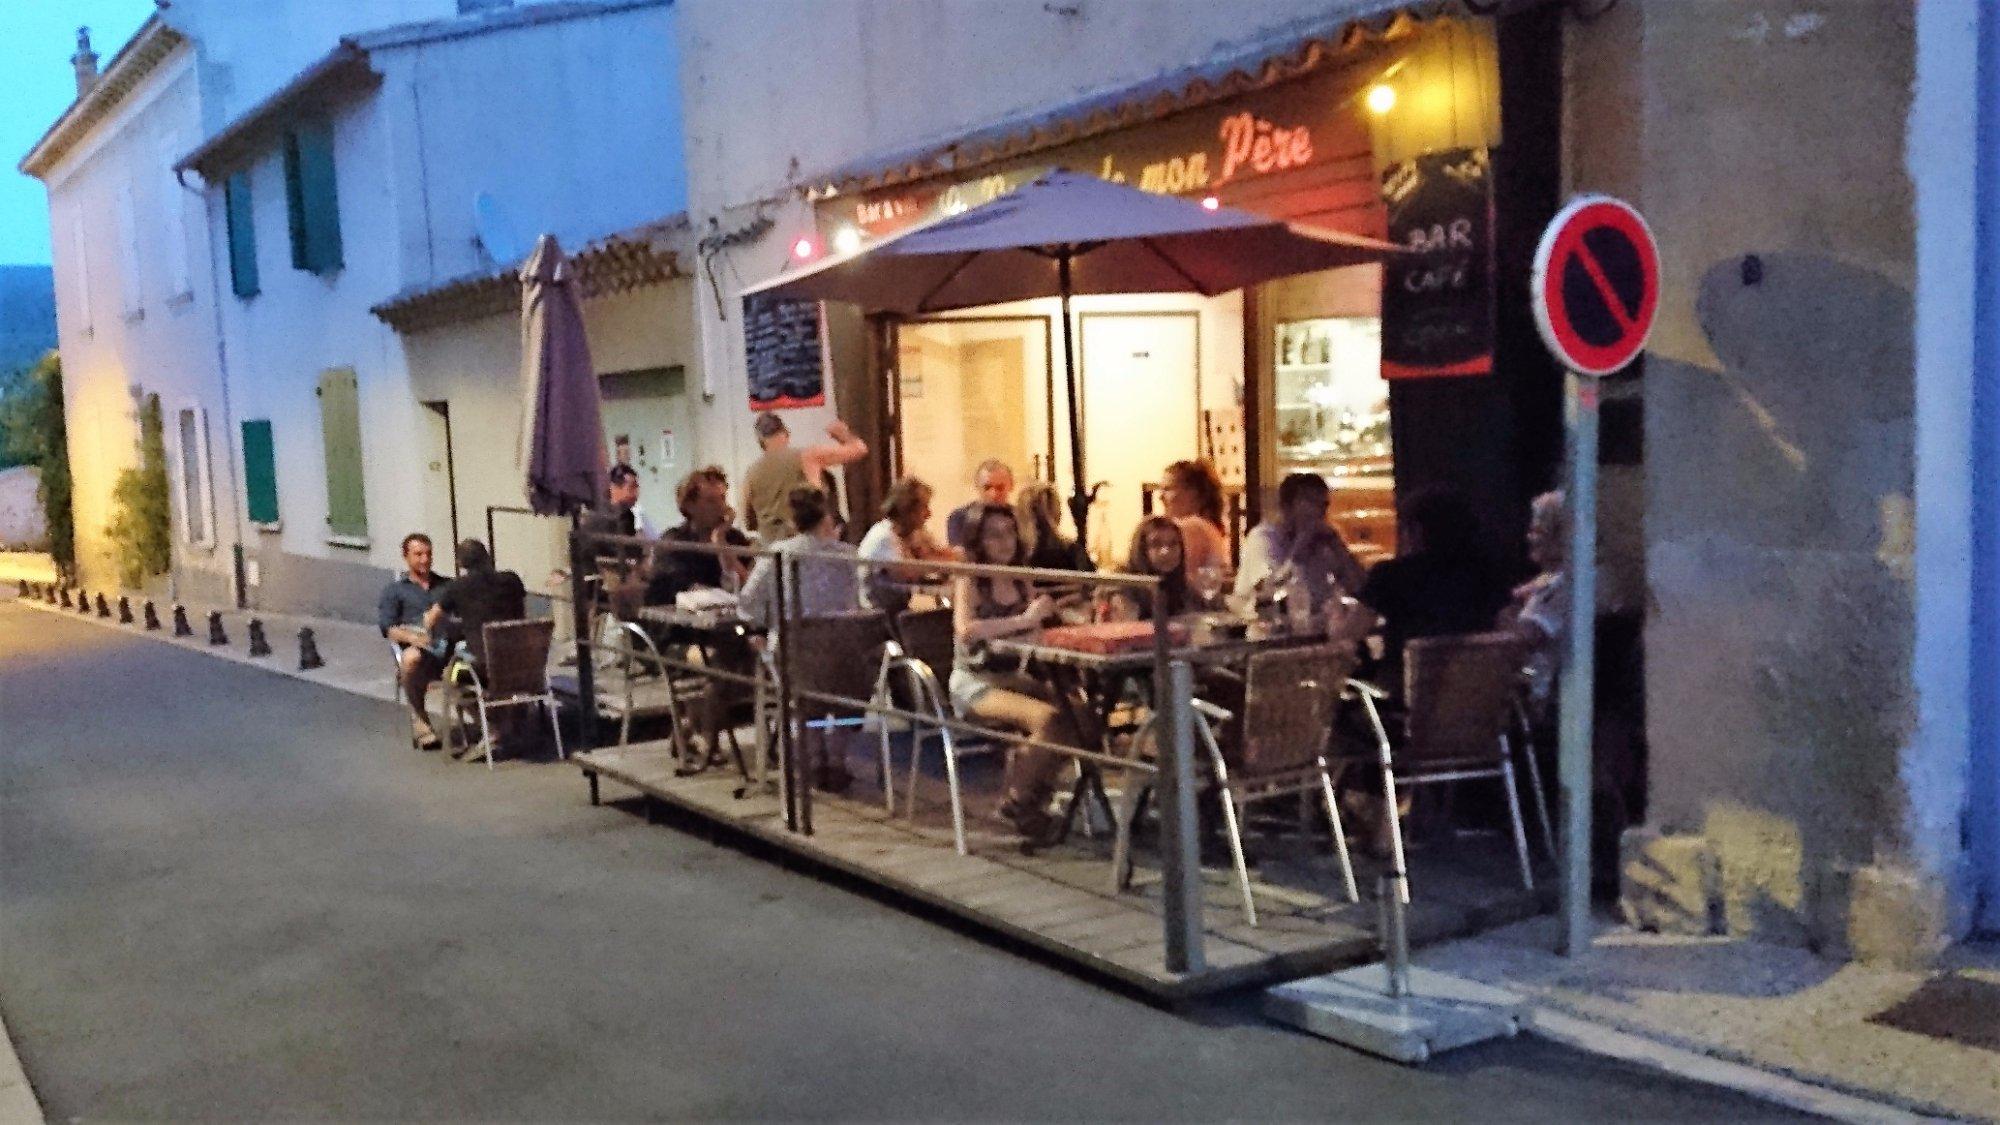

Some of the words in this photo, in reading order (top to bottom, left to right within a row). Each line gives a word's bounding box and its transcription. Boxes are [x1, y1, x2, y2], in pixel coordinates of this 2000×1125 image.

[1139, 152, 1210, 194] mon
[1214, 112, 1312, 184] Père
[1408, 218, 1474, 253] BAR
